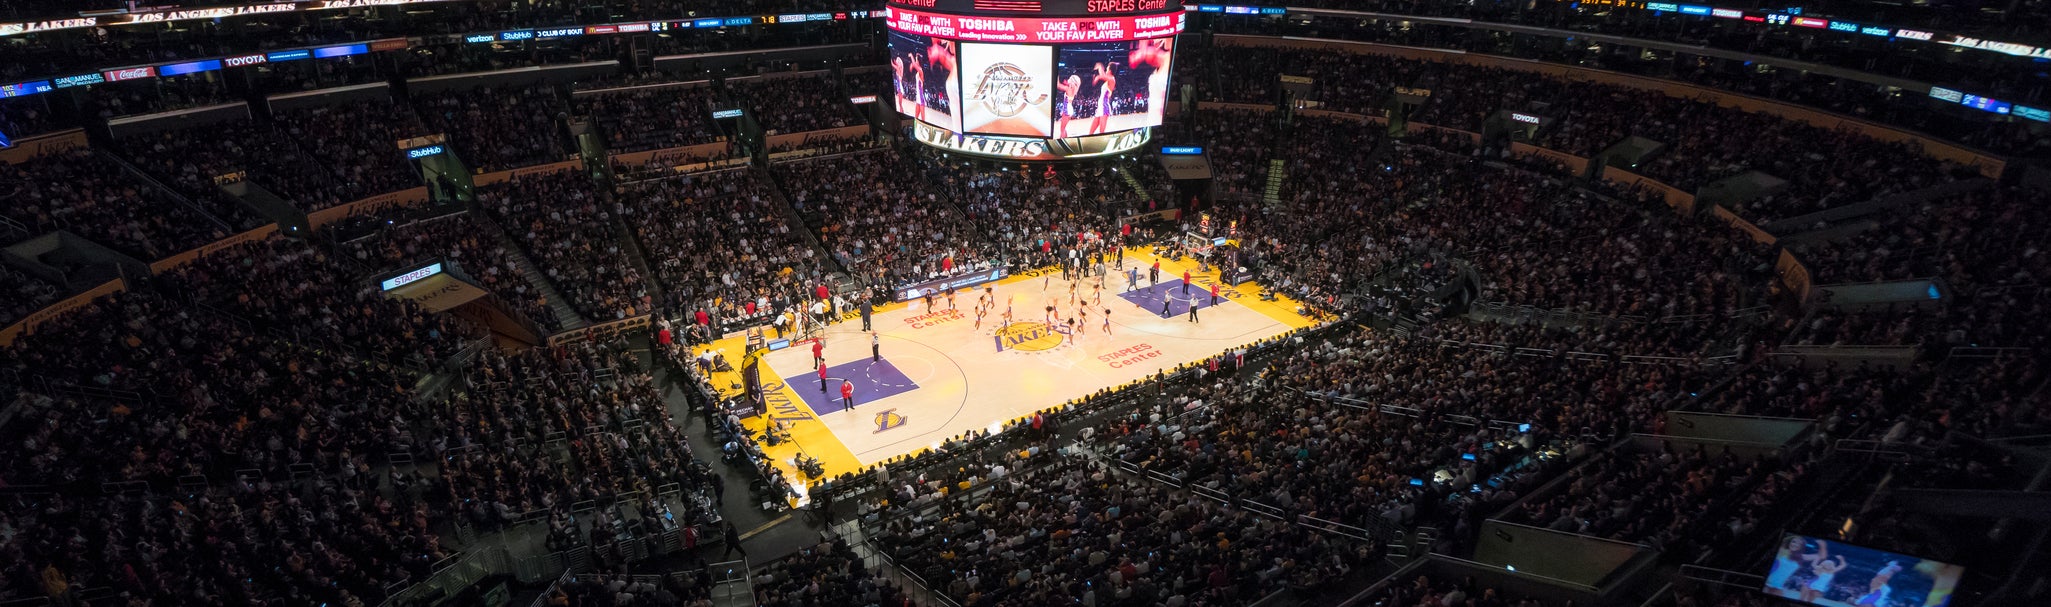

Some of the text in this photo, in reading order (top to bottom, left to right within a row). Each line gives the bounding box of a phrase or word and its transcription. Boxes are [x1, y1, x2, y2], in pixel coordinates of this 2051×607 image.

[322, 0, 350, 8] LOS
[1088, 0, 1166, 12] STAPLES Center
[131, 3, 296, 23] LOS ANGELES LAKERS
[28, 18, 96, 31] LAKERS
[900, 12, 912, 22] TAKE
[913, 14, 918, 23] A
[919, 15, 929, 24] PIC
[930, 17, 951, 27] WITH
[958, 18, 1014, 31] TOSHIBA
[1135, 16, 1170, 29] TOSHIBA
[618, 24, 649, 32] TOSHIBA
[898, 21, 910, 31] YOUR
[912, 23, 923, 33] FAV
[924, 25, 954, 36] PLAYER!
[1042, 21, 1120, 31] TAKE A PIC WITH
[1830, 21, 1857, 32] StubHub
[1862, 27, 1889, 36] verizon
[467, 34, 494, 42] verizon
[504, 31, 532, 40] StubHub
[959, 31, 979, 39] Leading
[1036, 30, 1123, 40] YOUR FAV PLAYER!
[1954, 36, 1980, 47] LOS
[225, 55, 266, 66] TOYOTA
[55, 73, 103, 85] SAN MANUEL
[119, 68, 147, 79] Coca-Cola
[850, 96, 876, 104] TOSHIBA
[1512, 113, 1539, 124] TOYOTA
[931, 131, 1045, 158] LAKERS
[1103, 130, 1143, 153] LOS
[411, 146, 442, 158] StubHub
[395, 267, 431, 286] STAPLES
[904, 308, 959, 324] STAPLES
[1097, 343, 1152, 362] STAPLES
[1109, 350, 1162, 368] Center
